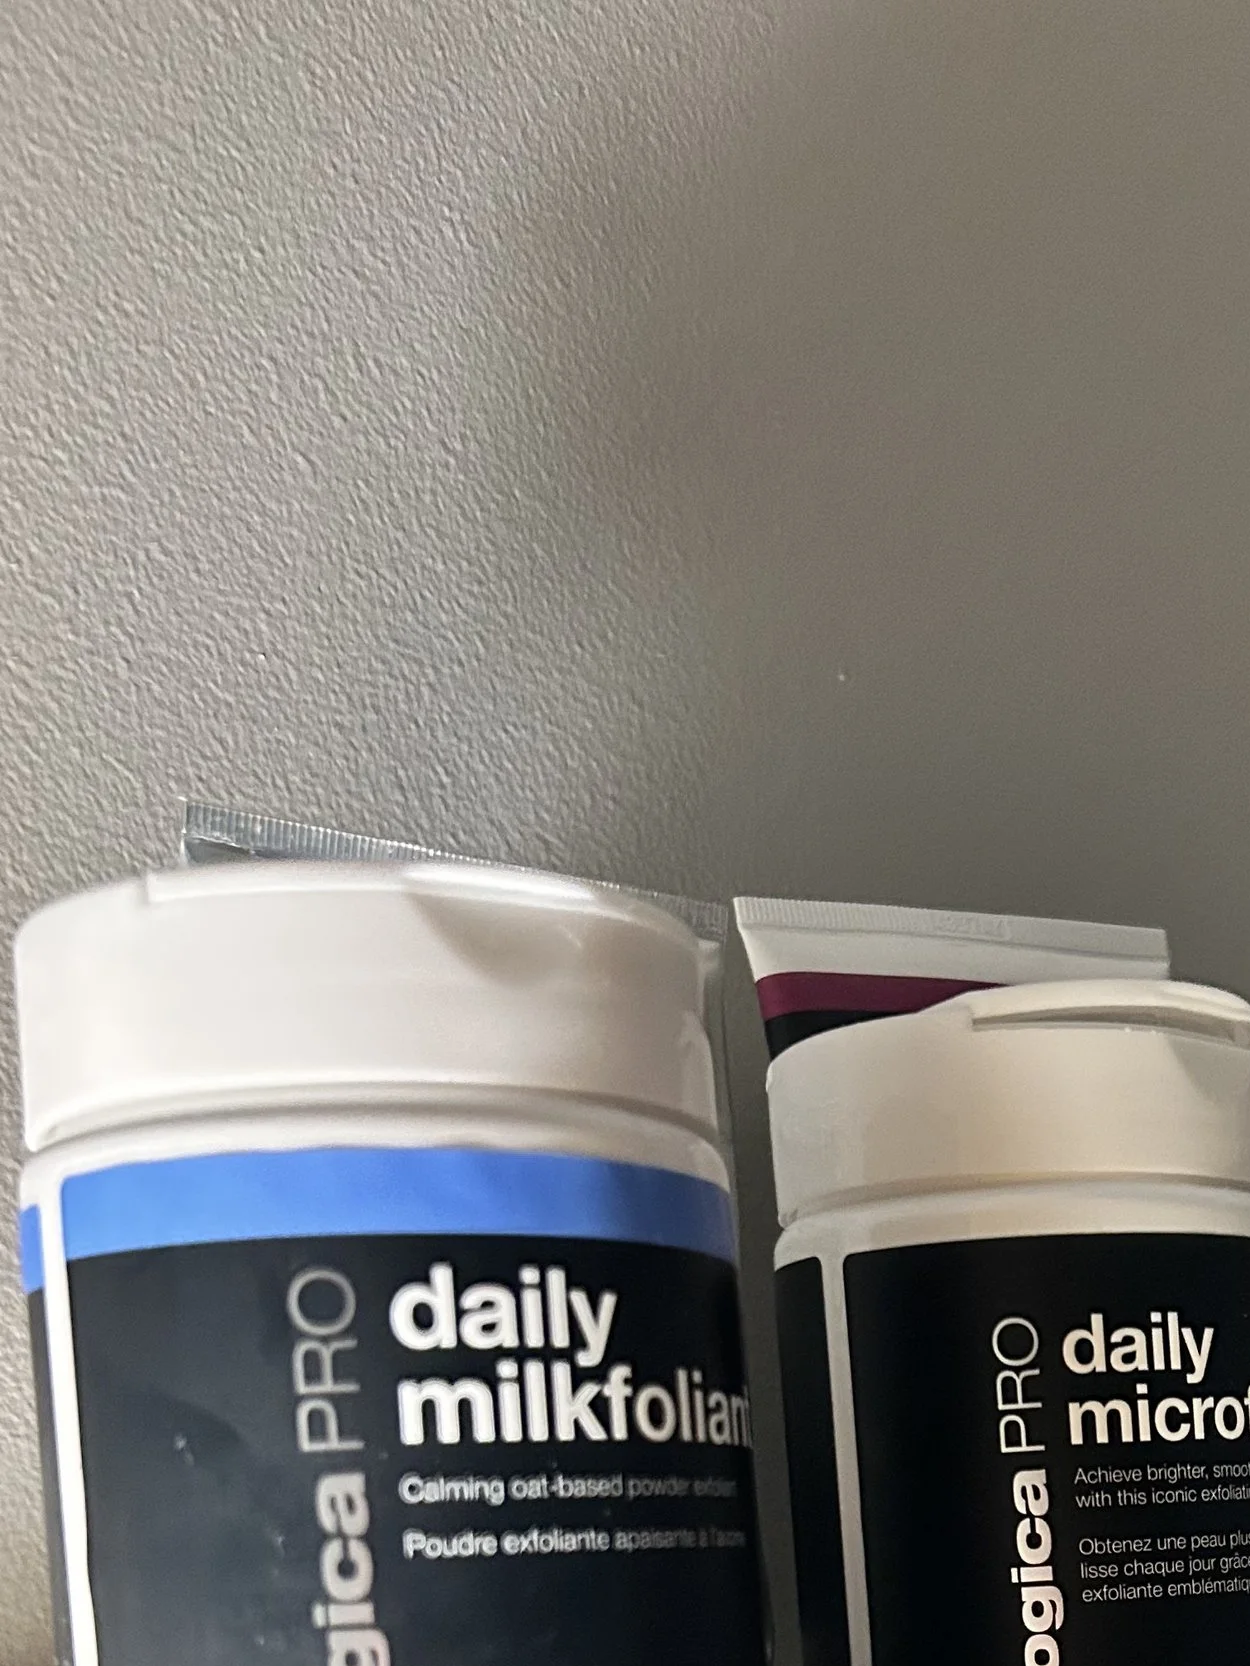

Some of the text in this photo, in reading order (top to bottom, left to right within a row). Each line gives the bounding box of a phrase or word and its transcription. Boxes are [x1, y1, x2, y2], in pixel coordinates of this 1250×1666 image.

[389, 1261, 618, 1368] daily
[286, 1265, 366, 1453] PRO
[1061, 1311, 1215, 1384] daily
[991, 1316, 1047, 1454] PRO
[398, 1472, 506, 1506] Calming
[509, 1473, 623, 1500] oat-based
[1073, 1466, 1143, 1486] Achieve
[1146, 1463, 1210, 1485] brighter,
[1075, 1489, 1112, 1509] with
[1117, 1487, 1147, 1507] this
[1151, 1485, 1198, 1504] iconic
[402, 1528, 498, 1561] Poudre
[501, 1525, 612, 1556] exfoliante
[1078, 1537, 1153, 1556] Obtenez
[1157, 1536, 1188, 1552] une
[1190, 1534, 1227, 1553] peau
[1079, 1560, 1120, 1579] lisse
[1123, 1557, 1185, 1578] chaque
[1187, 1555, 1216, 1576] jour
[1081, 1582, 1164, 1603] exfoliante
